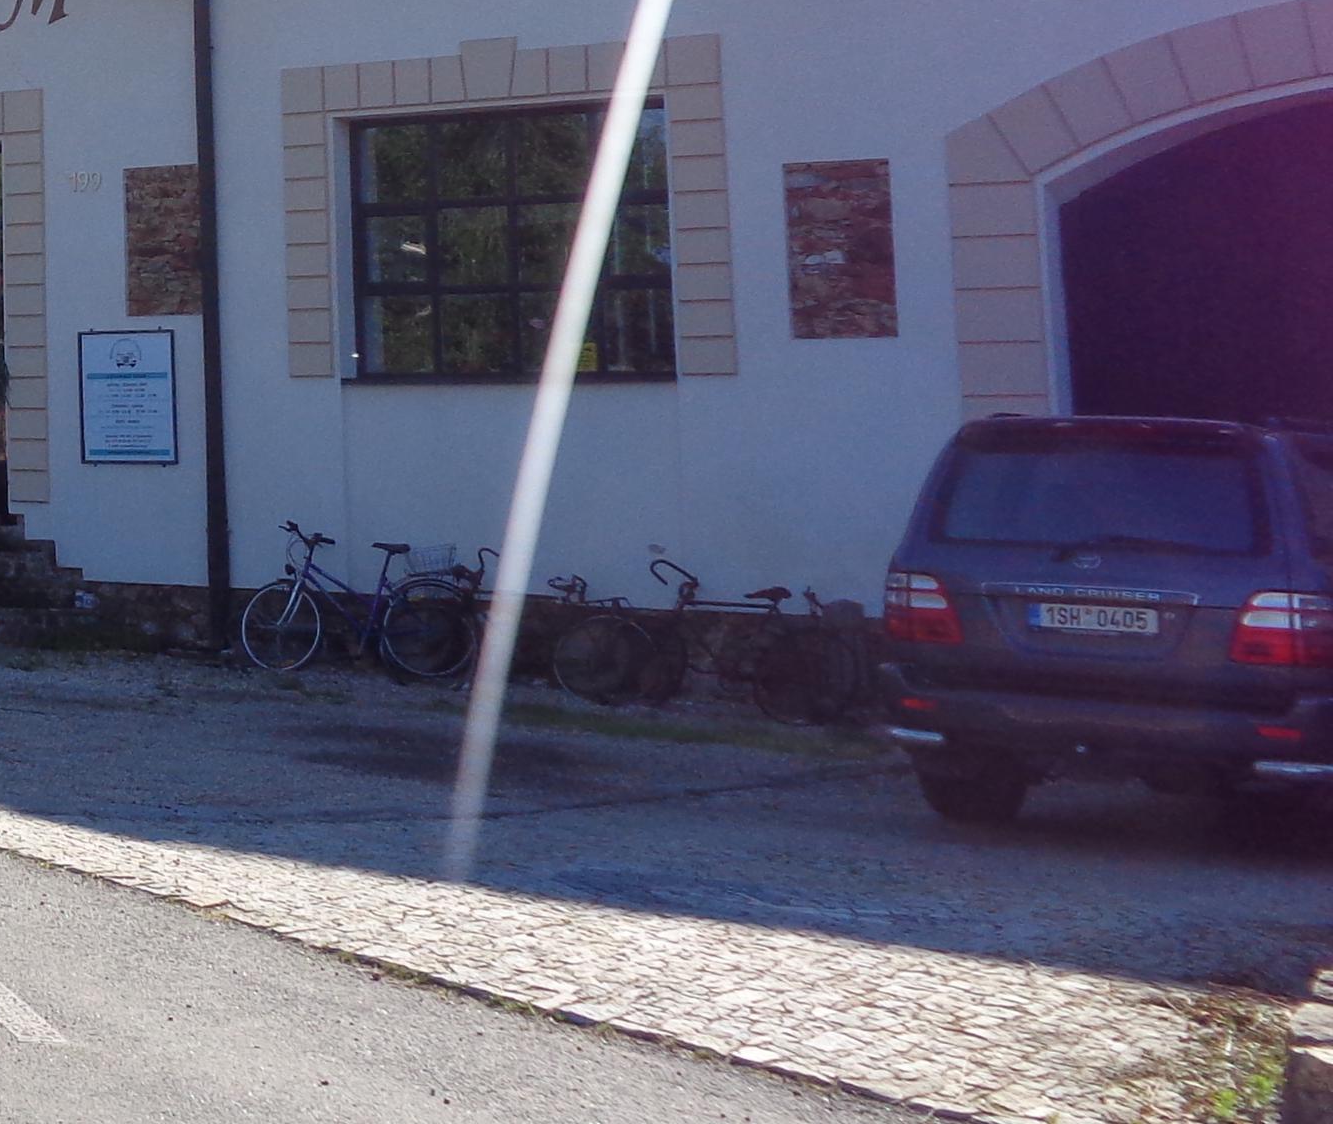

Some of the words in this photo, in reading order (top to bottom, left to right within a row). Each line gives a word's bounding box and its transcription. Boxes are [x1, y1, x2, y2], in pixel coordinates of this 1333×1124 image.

[68, 171, 102, 193] 199
[1014, 586, 1065, 597] LAND
[1073, 588, 1161, 602] CRUISER
[1045, 605, 1082, 627] 1SH
[1096, 610, 1149, 631] 0405
